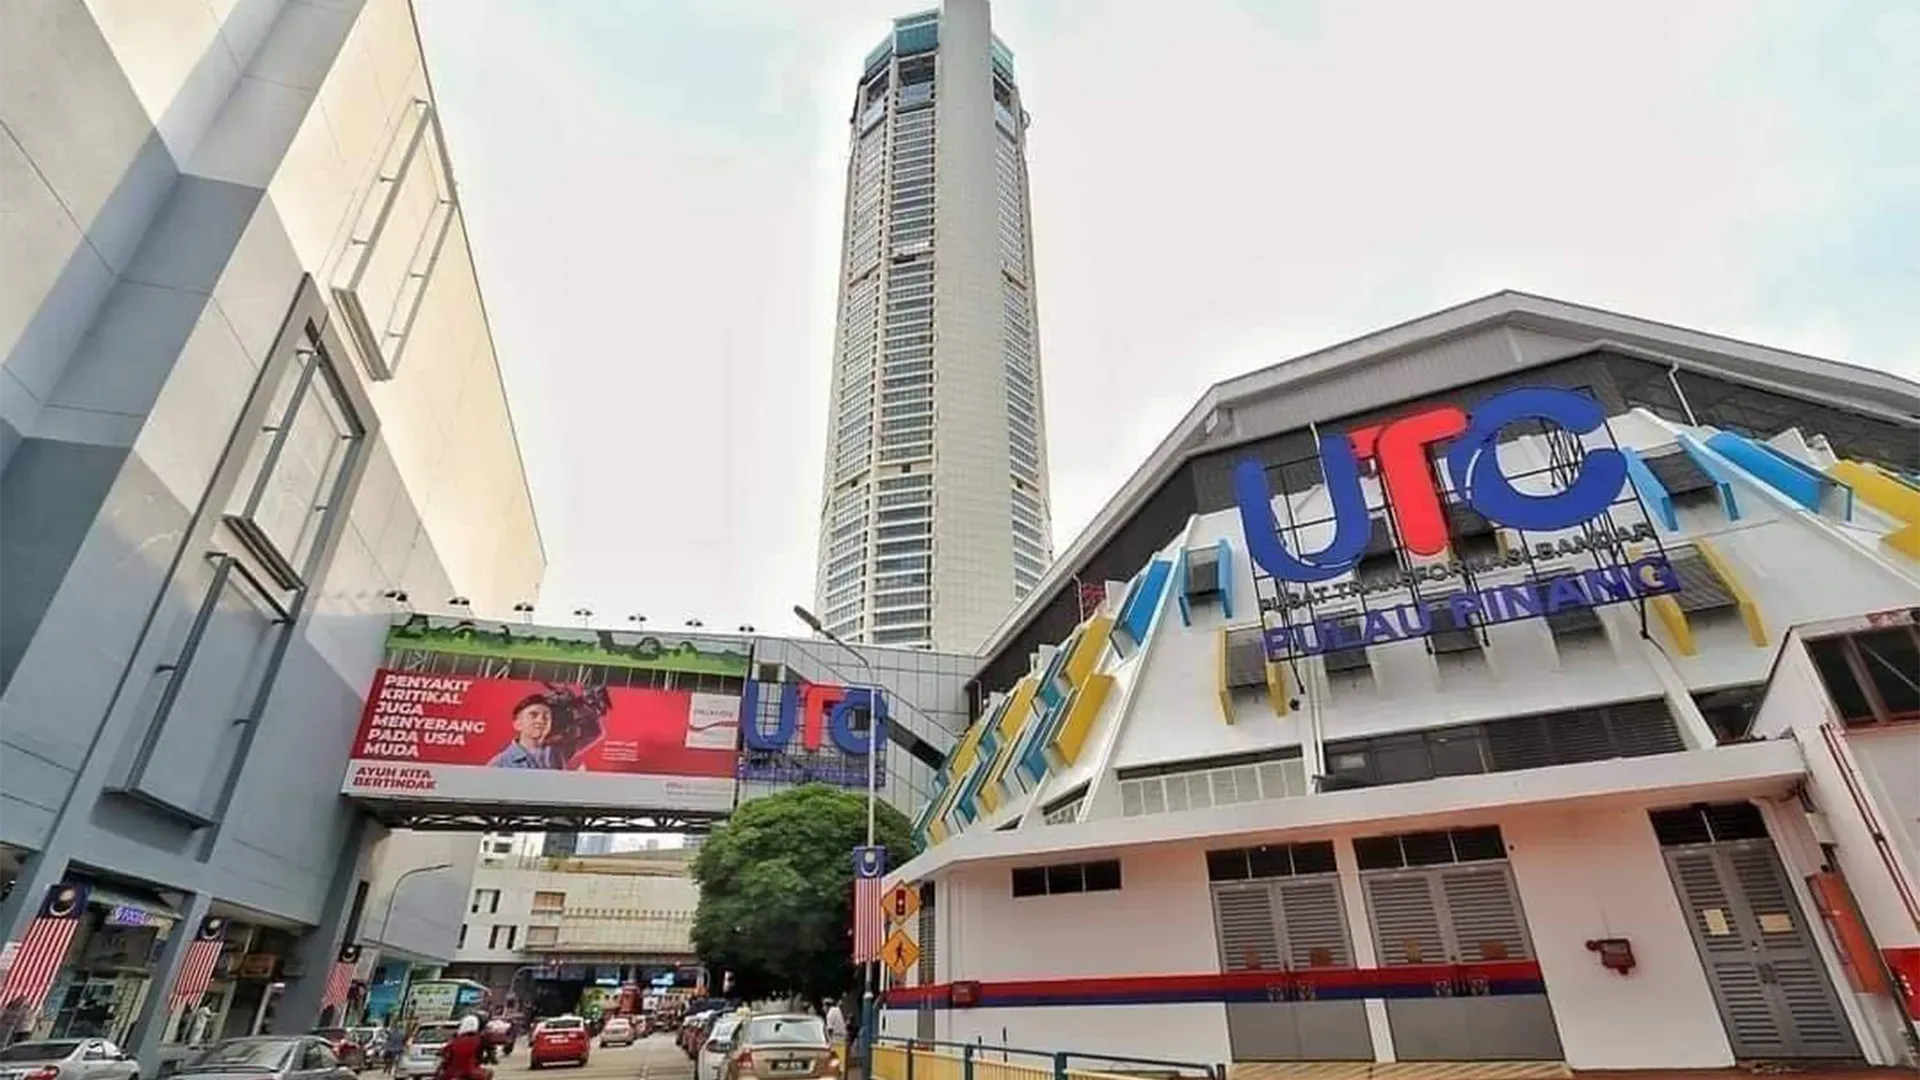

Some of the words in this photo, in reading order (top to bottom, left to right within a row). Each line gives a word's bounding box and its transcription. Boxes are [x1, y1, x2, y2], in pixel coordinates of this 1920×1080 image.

[1236, 386, 1628, 582] UTC
[1264, 601, 1432, 661] PULAU
[1449, 554, 1681, 629] PINANG
[384, 674, 473, 692] PENYAKIT
[380, 688, 463, 704] KRITIKAL
[375, 701, 424, 716] JUGA
[741, 680, 889, 754] UTC
[371, 714, 487, 734] MENYERANG
[367, 728, 420, 743] PADA
[424, 731, 466, 746] USIA
[363, 742, 420, 757] MUDA
[356, 766, 397, 778] AYUH
[400, 768, 432, 779] KITA
[353, 777, 437, 790] BERTINDAK
